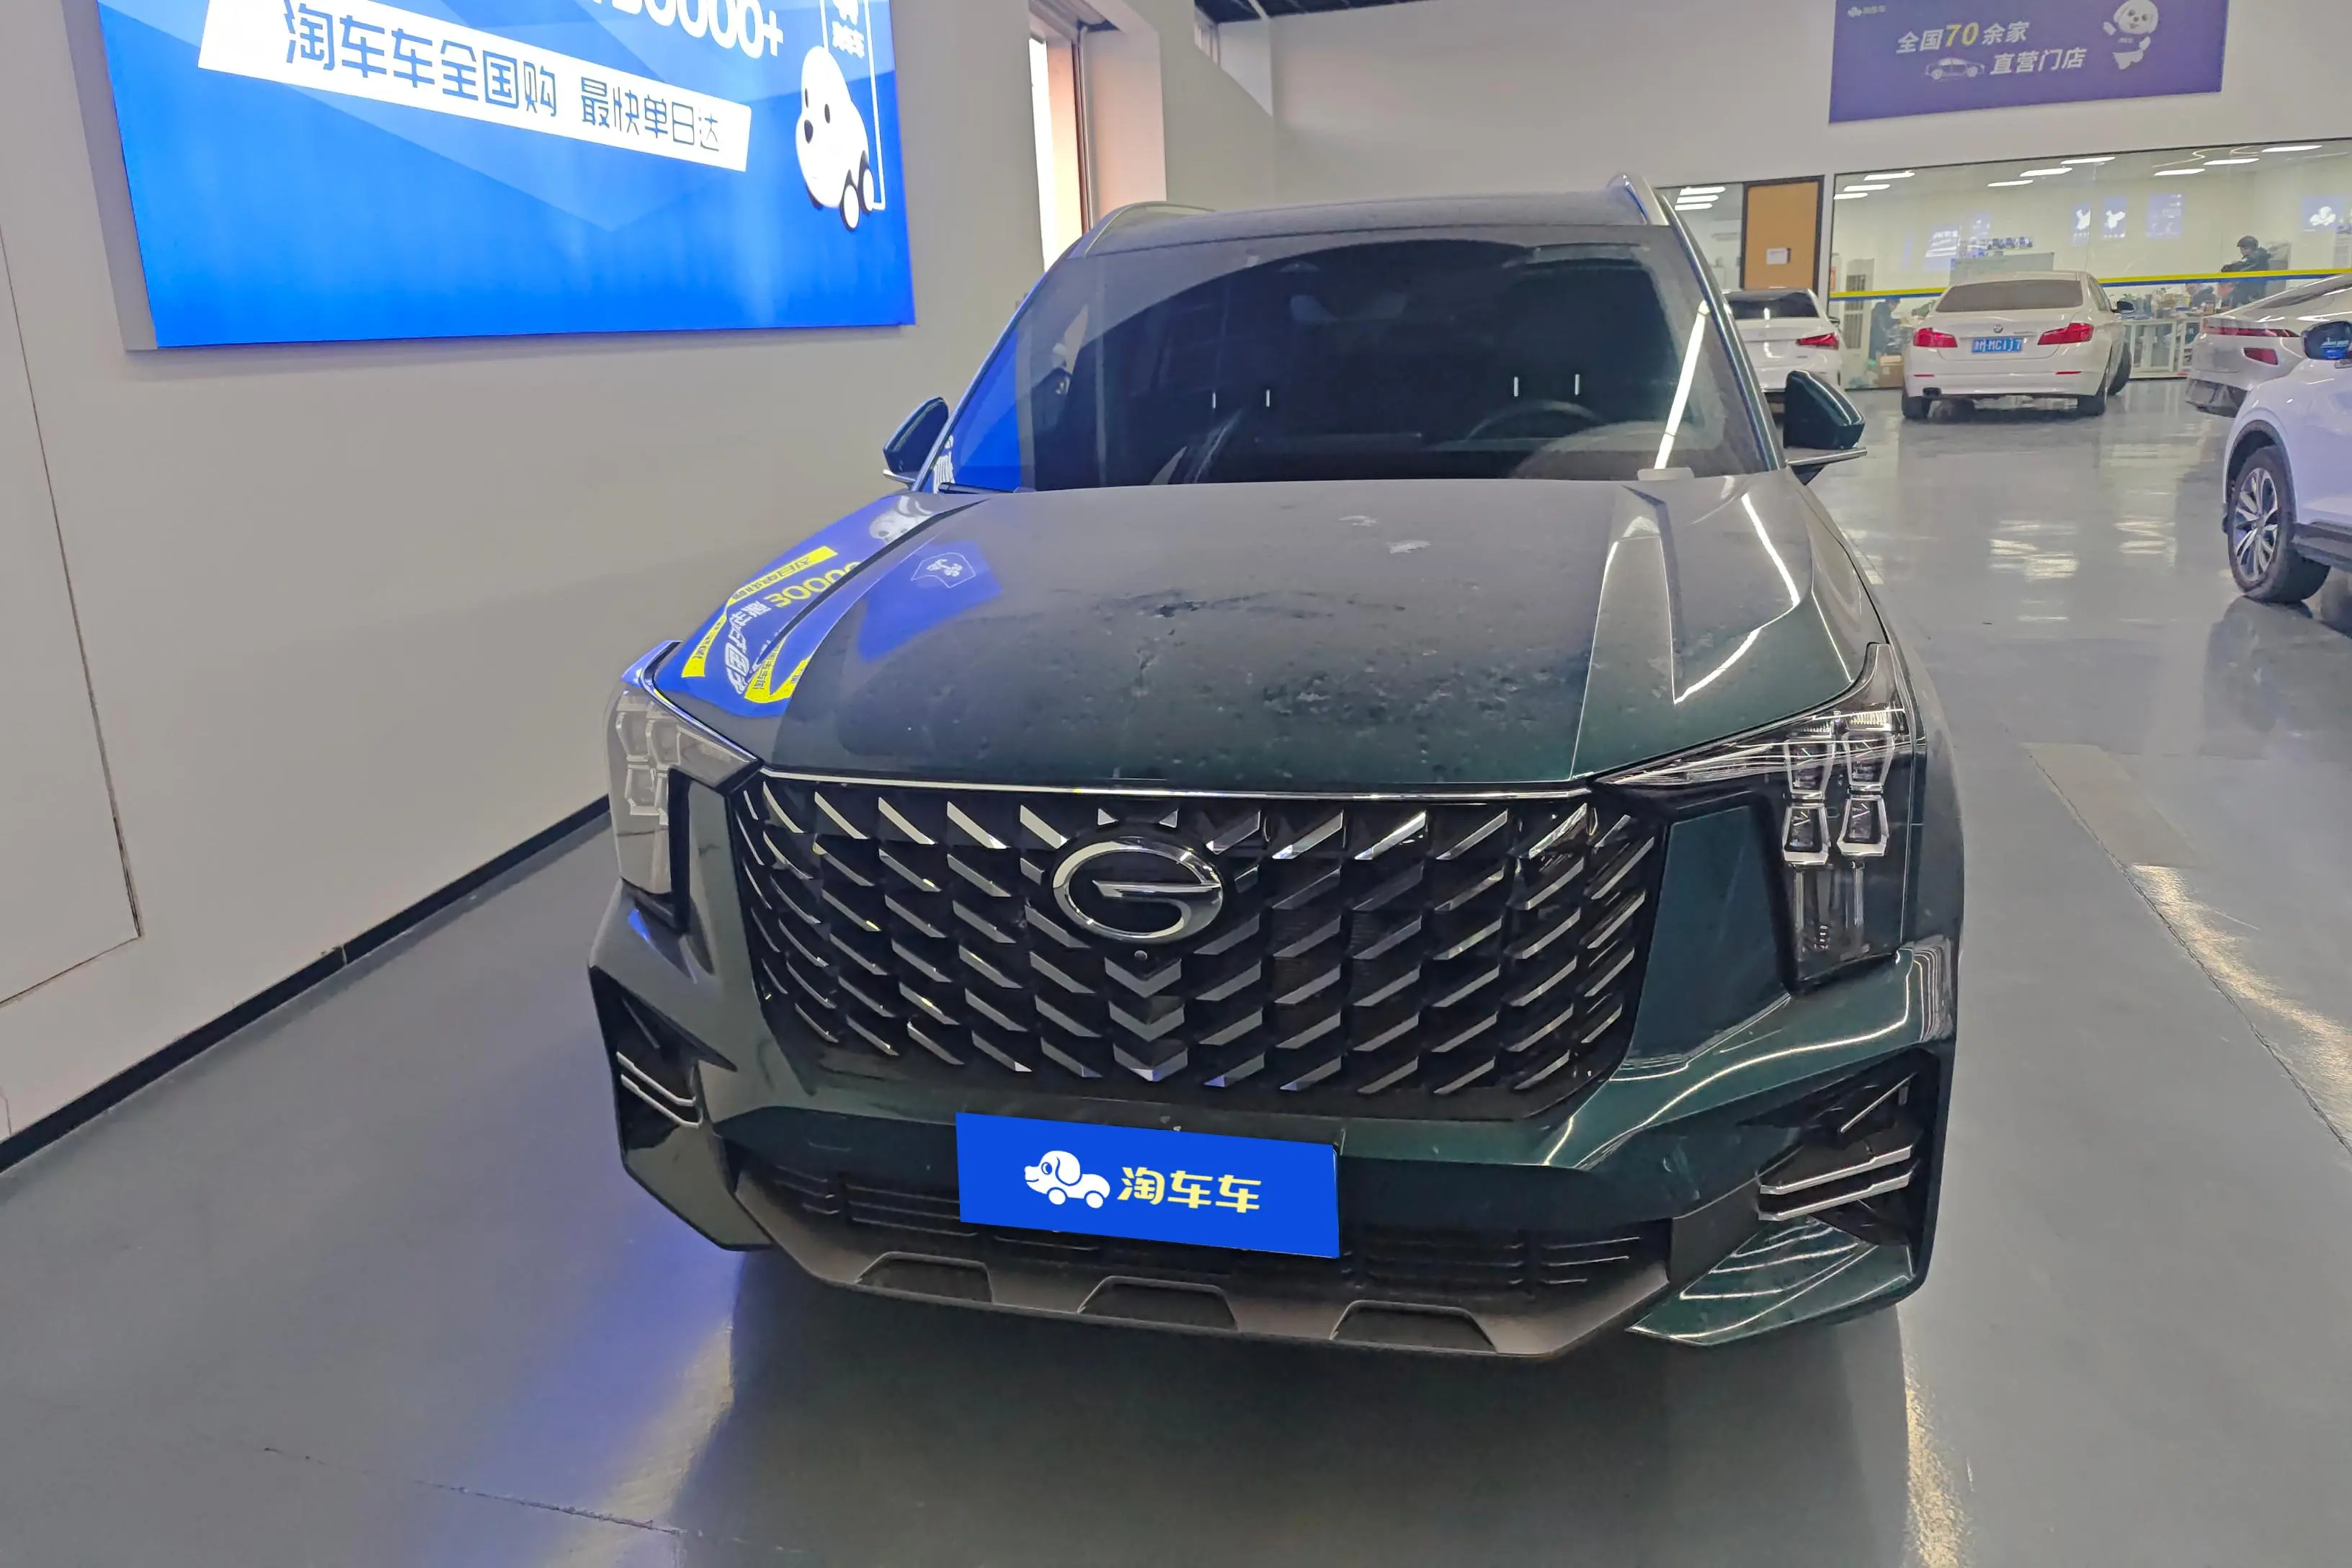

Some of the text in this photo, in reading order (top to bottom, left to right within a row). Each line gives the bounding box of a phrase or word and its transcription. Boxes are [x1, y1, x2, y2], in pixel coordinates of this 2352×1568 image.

[284, 0, 720, 151] 淘车车全国购 最快单日达
[1990, 46, 2088, 76] 直营门店
